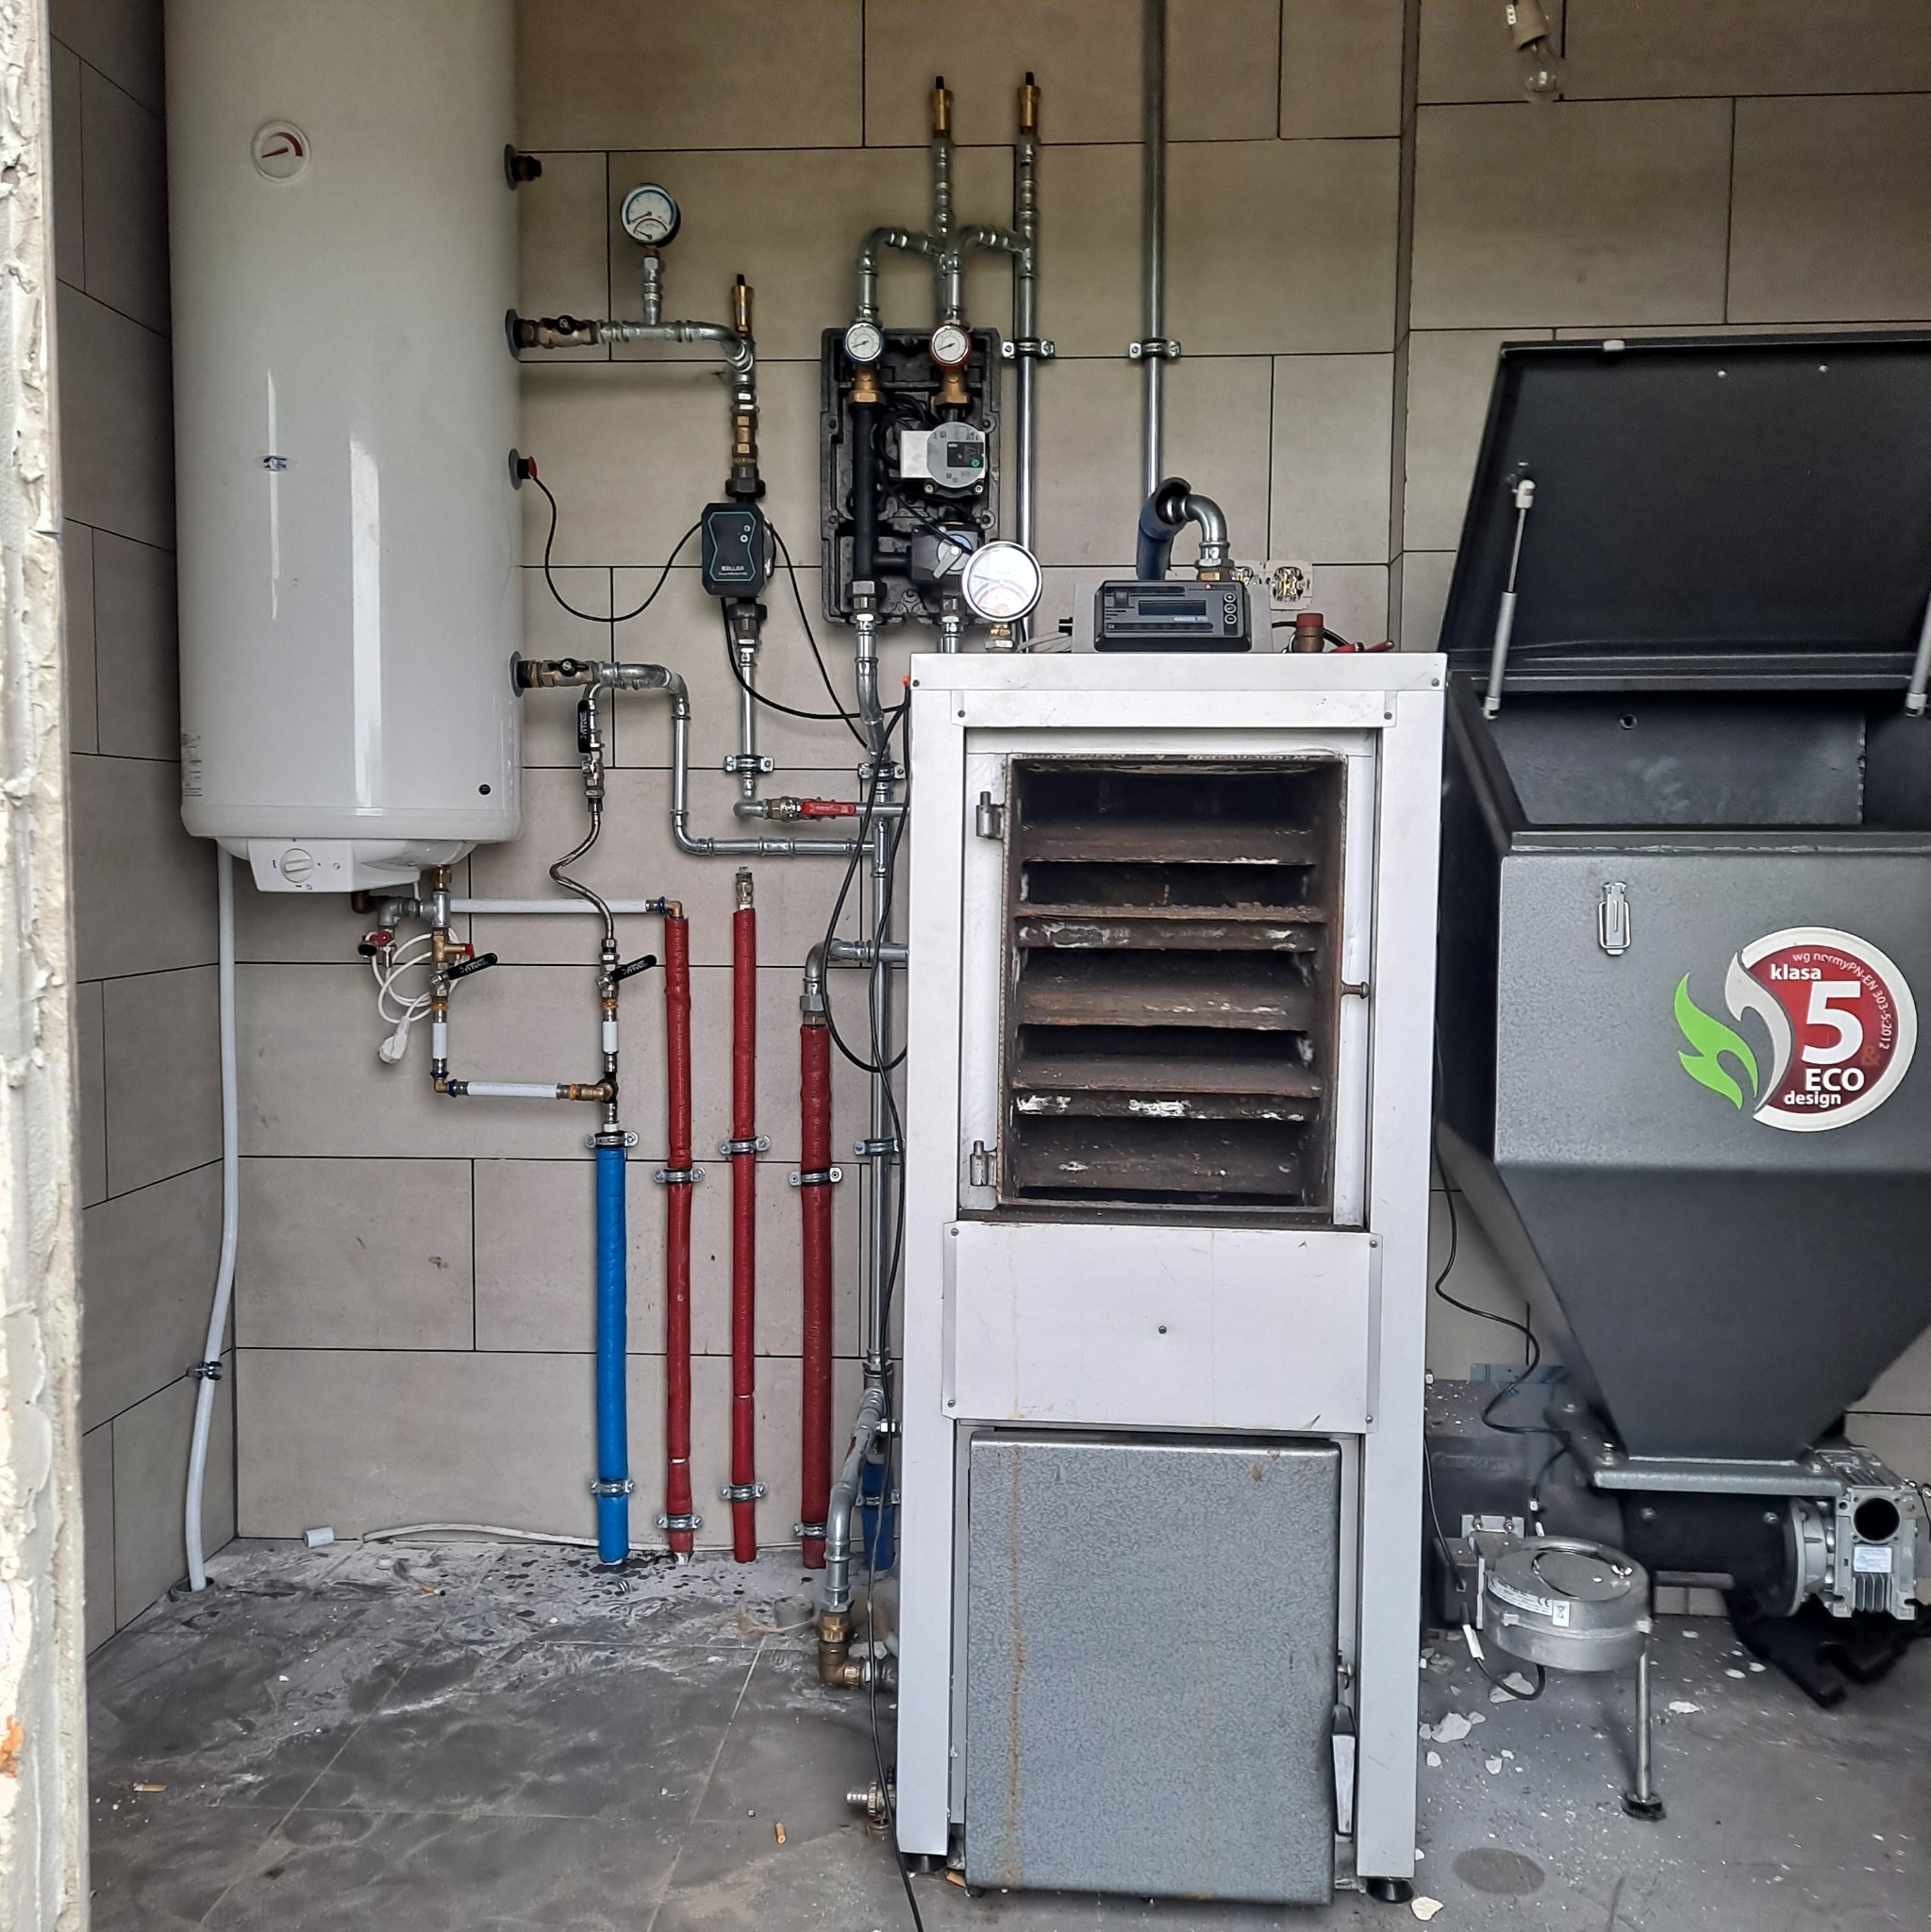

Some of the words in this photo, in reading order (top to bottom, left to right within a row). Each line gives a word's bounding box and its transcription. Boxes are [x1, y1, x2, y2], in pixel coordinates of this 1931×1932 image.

[1792, 953, 1810, 963] wg
[1771, 963, 1822, 980] klasa
[1802, 981, 1863, 1064] 5
[1805, 1068, 1865, 1091] ECO
[1784, 1090, 1841, 1108] design
